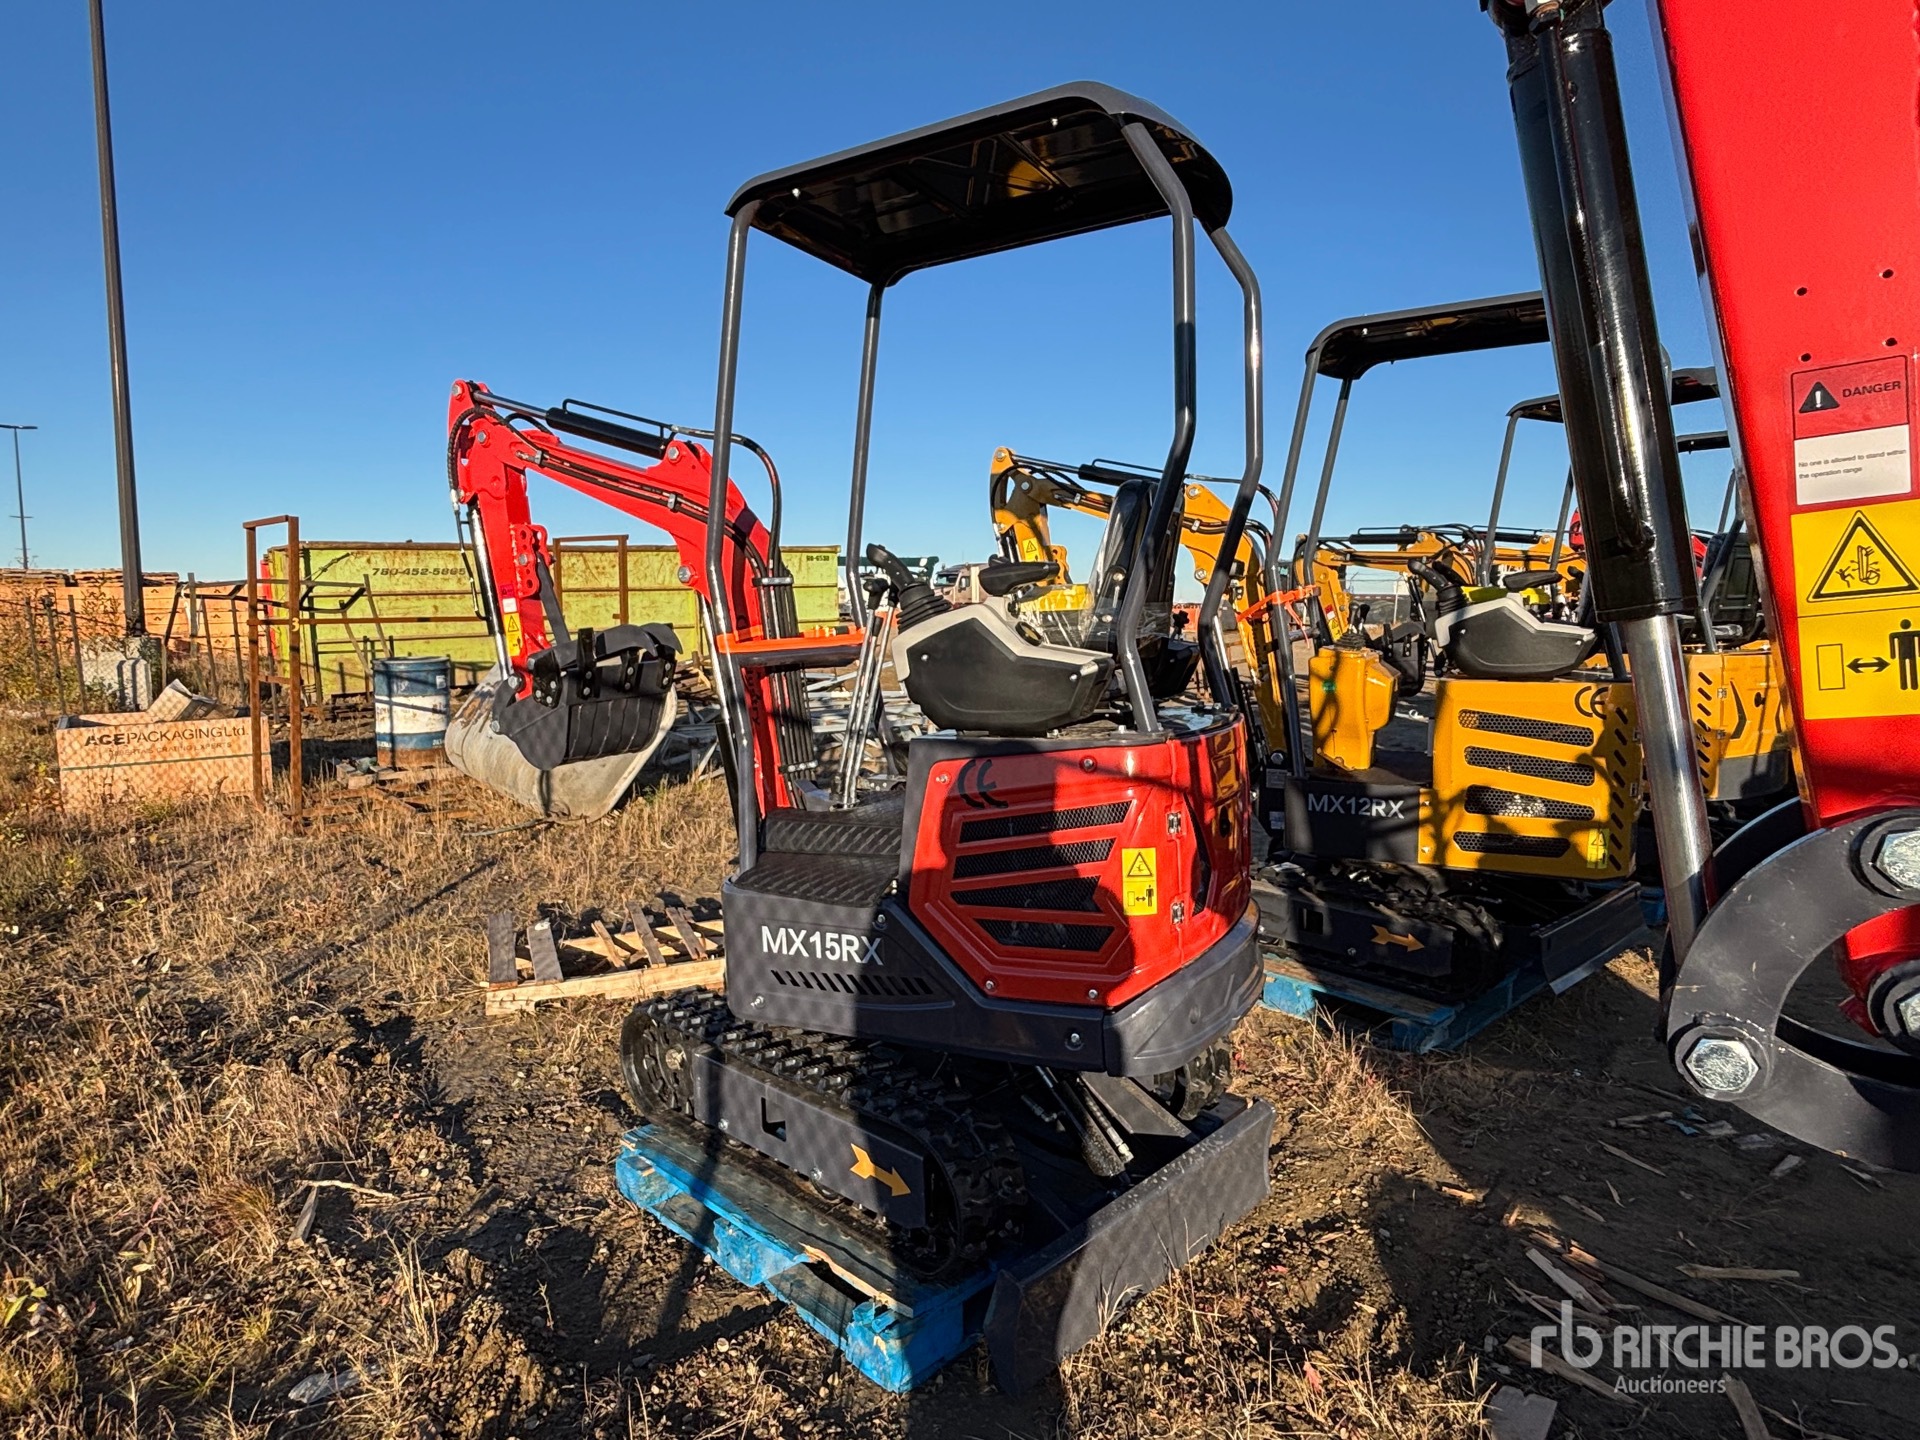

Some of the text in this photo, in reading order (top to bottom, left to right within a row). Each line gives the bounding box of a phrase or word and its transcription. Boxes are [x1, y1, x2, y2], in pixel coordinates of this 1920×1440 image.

[1842, 380, 1902, 398] DANGER
[1831, 455, 1856, 464] allowed
[1866, 451, 1885, 460] stand
[1886, 449, 1907, 457] within
[1811, 469, 1841, 478] operation
[1843, 466, 1862, 474] range
[1308, 793, 1405, 819] MX12RX
[761, 925, 884, 966] MX15RX
